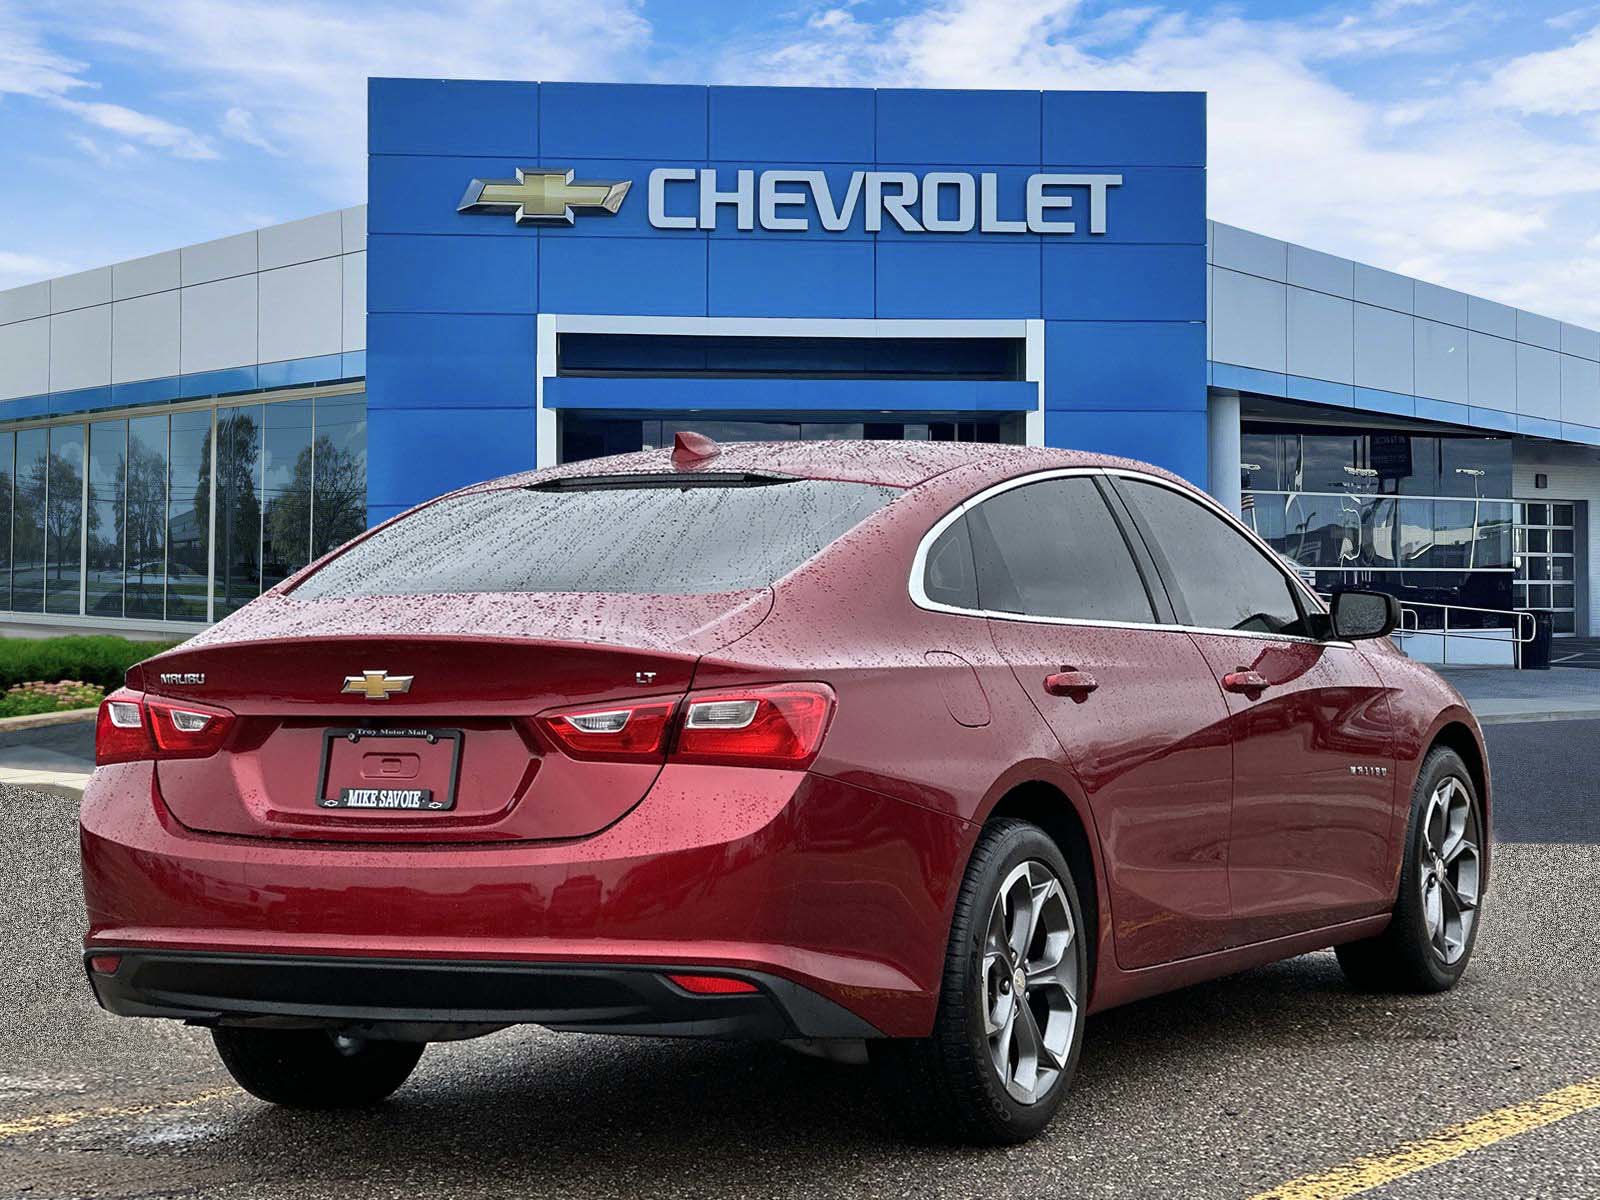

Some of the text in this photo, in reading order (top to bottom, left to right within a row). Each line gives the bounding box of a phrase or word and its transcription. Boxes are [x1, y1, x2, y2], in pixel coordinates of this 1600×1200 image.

[648, 168, 1123, 234] CHEVROLET
[160, 673, 205, 685] MALIBU
[636, 672, 657, 684] LT
[357, 728, 427, 737] Troy Motor Mall
[347, 789, 422, 809] MIKE SAVOIE
